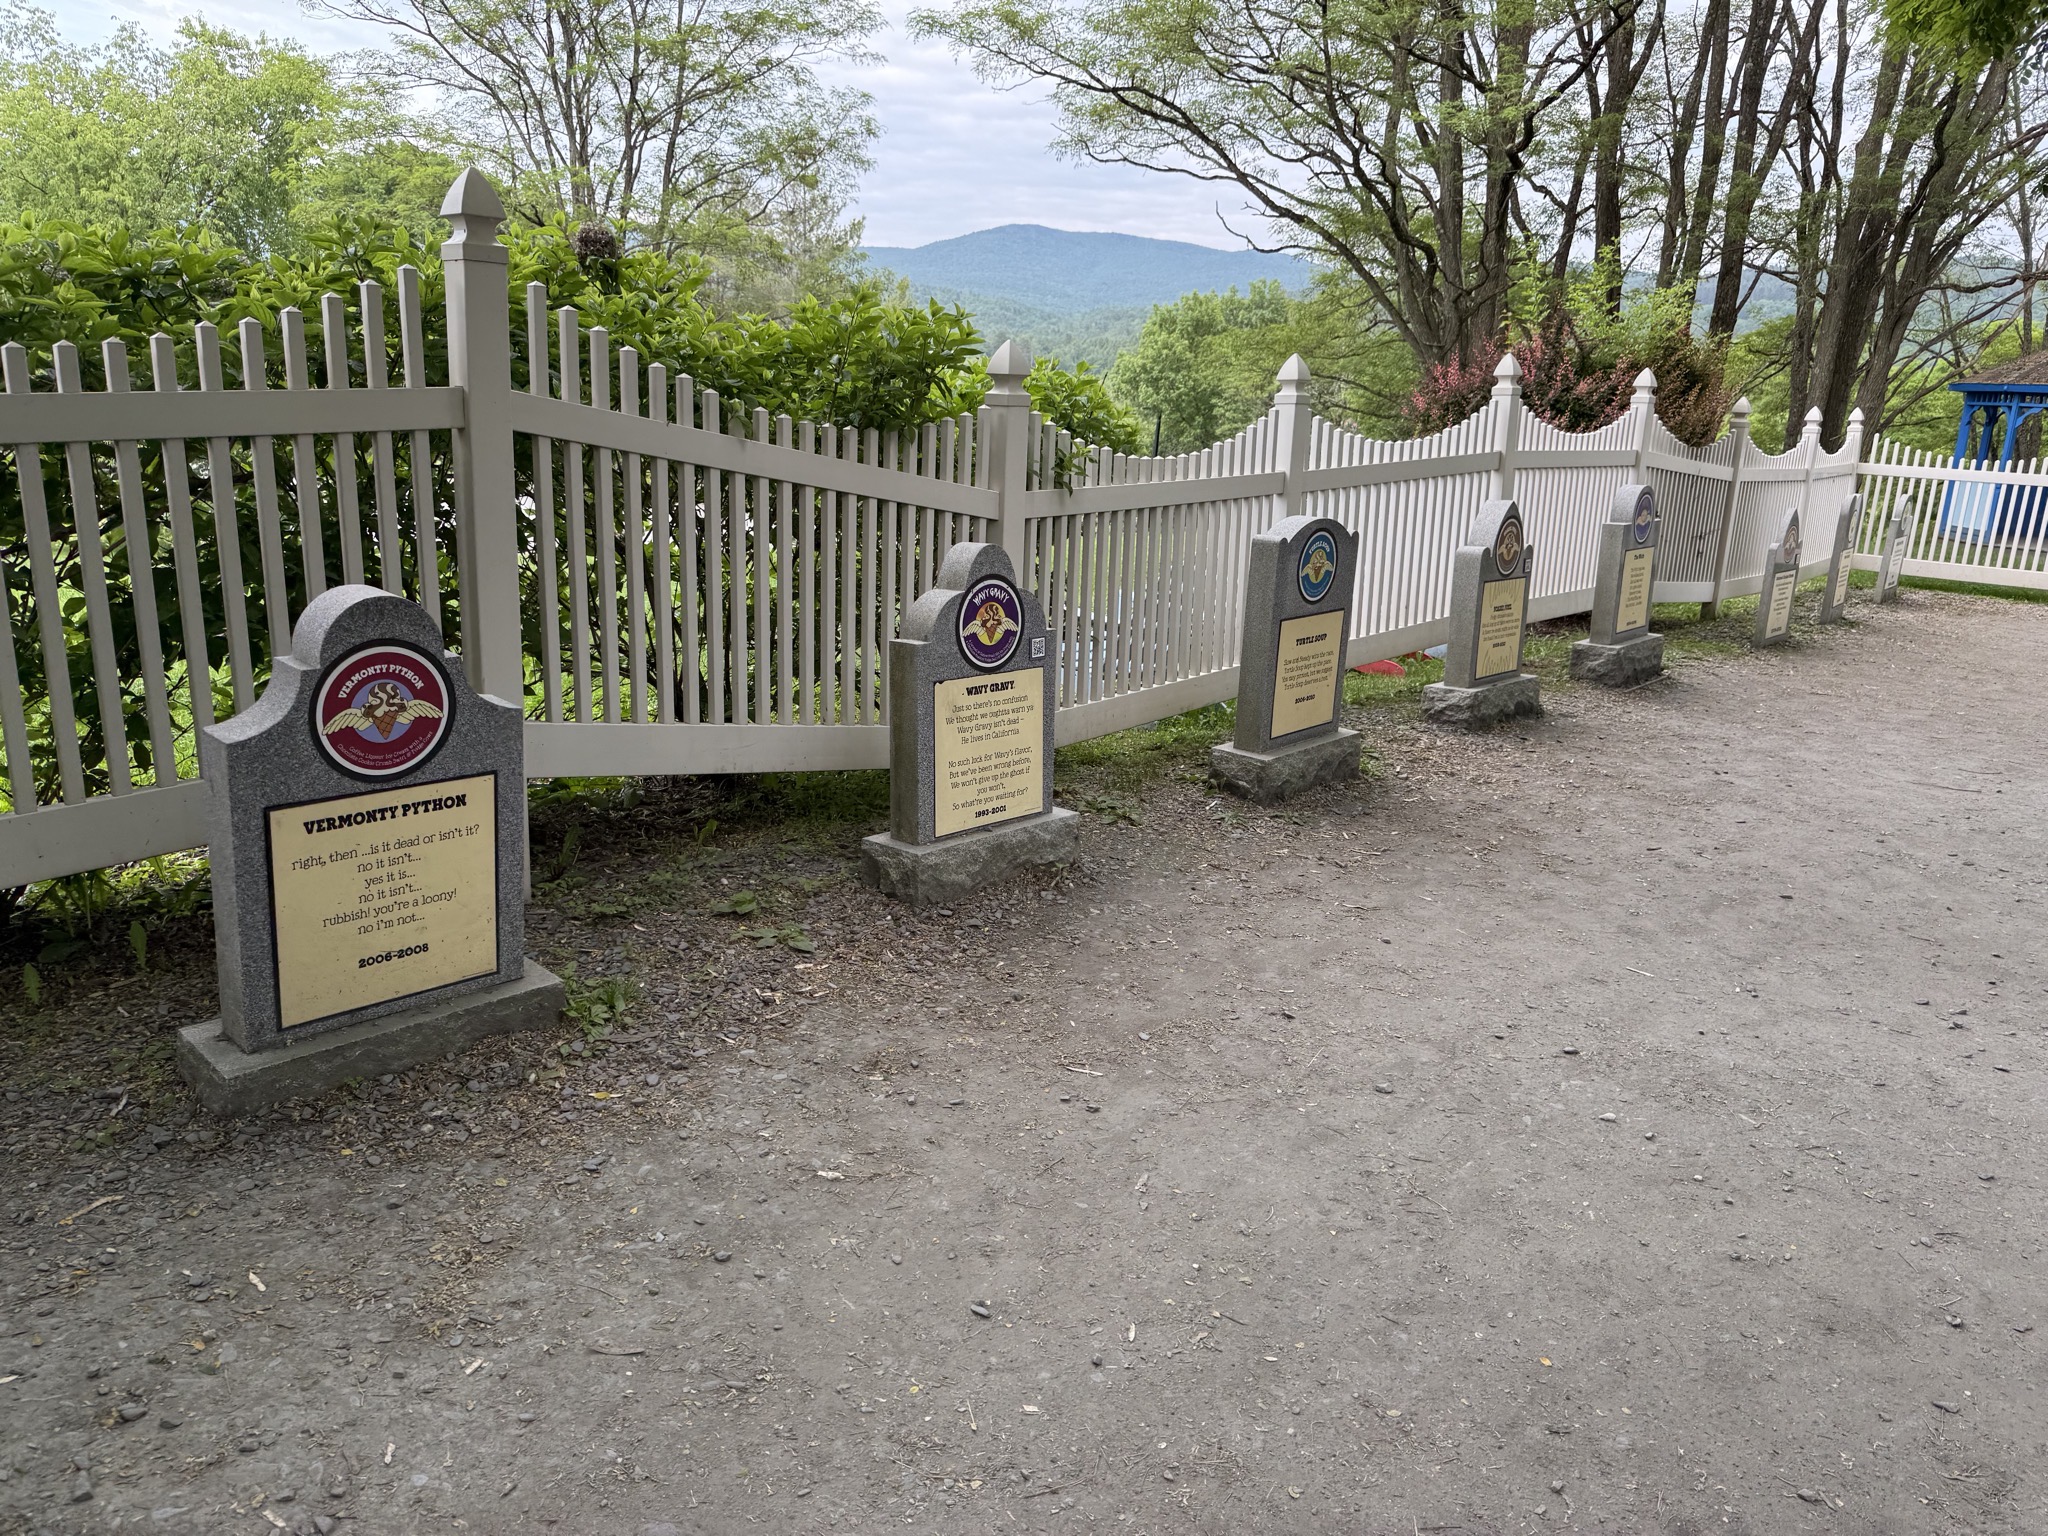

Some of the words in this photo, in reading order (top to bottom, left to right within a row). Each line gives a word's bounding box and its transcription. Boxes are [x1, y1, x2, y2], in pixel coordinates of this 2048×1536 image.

[973, 589, 989, 606] WAVY
[990, 588, 1010, 603] GRAVY
[1296, 636, 1314, 646] TURTLE
[1315, 633, 1327, 642] SOUP
[338, 664, 387, 699] VERMONTY
[389, 664, 425, 690] PYTHON
[966, 684, 988, 696] WAVY
[990, 681, 1014, 692] GRAVY
[952, 705, 964, 713] Just
[973, 700, 992, 709] there's
[1002, 694, 1028, 705] confusion
[946, 717, 955, 725] We
[956, 714, 978, 724] thought
[1011, 706, 1025, 714] warn
[957, 725, 973, 734] Wavy
[975, 723, 992, 731] Gravy
[994, 719, 1005, 727] isn't
[1006, 717, 1019, 726] dead
[961, 736, 969, 744] He
[970, 734, 983, 743] lives
[984, 732, 991, 740] in
[992, 728, 1019, 739] California
[949, 760, 956, 768] No
[958, 758, 970, 767] such
[972, 755, 983, 764] luck
[984, 753, 993, 762] for
[994, 749, 1014, 759] Wavy's
[949, 771, 959, 779] But
[961, 768, 977, 777] we've
[978, 765, 992, 773] been
[994, 760, 1011, 770] wrong
[951, 781, 960, 789] We
[961, 778, 978, 787] won't
[978, 776, 990, 785] give
[991, 774, 999, 782] up
[1000, 771, 1009, 779] the
[1010, 768, 1024, 778] ghost
[1025, 766, 1030, 774] if
[952, 802, 960, 810] So
[961, 798, 982, 808] what're
[984, 796, 994, 805] you
[995, 789, 1016, 800] waiting
[1017, 787, 1028, 797] for?
[977, 787, 987, 796] you
[303, 805, 398, 835] VERMONTY
[401, 794, 467, 817] PYTHON
[975, 805, 1006, 818] 1993-2001
[292, 855, 326, 871] right,
[329, 848, 358, 864] then
[382, 841, 391, 853] it
[394, 835, 420, 850] dead
[423, 834, 436, 844] or
[439, 828, 463, 841] isn't
[465, 824, 480, 836] it?
[357, 862, 373, 873] no
[376, 857, 385, 869] it
[388, 852, 421, 867] isn't...
[364, 876, 384, 889] yes
[386, 872, 395, 883] it
[398, 868, 416, 880] is...
[358, 892, 374, 904] no
[377, 888, 386, 899] it
[389, 883, 422, 897] isn't...
[322, 909, 370, 928] rubbish!
[373, 900, 409, 917] you're
[412, 898, 419, 907] a
[422, 888, 457, 906] loony!
[358, 923, 374, 935] no
[376, 919, 394, 930] i'm
[397, 914, 425, 926] not...
[358, 943, 429, 969] 2006-2008
